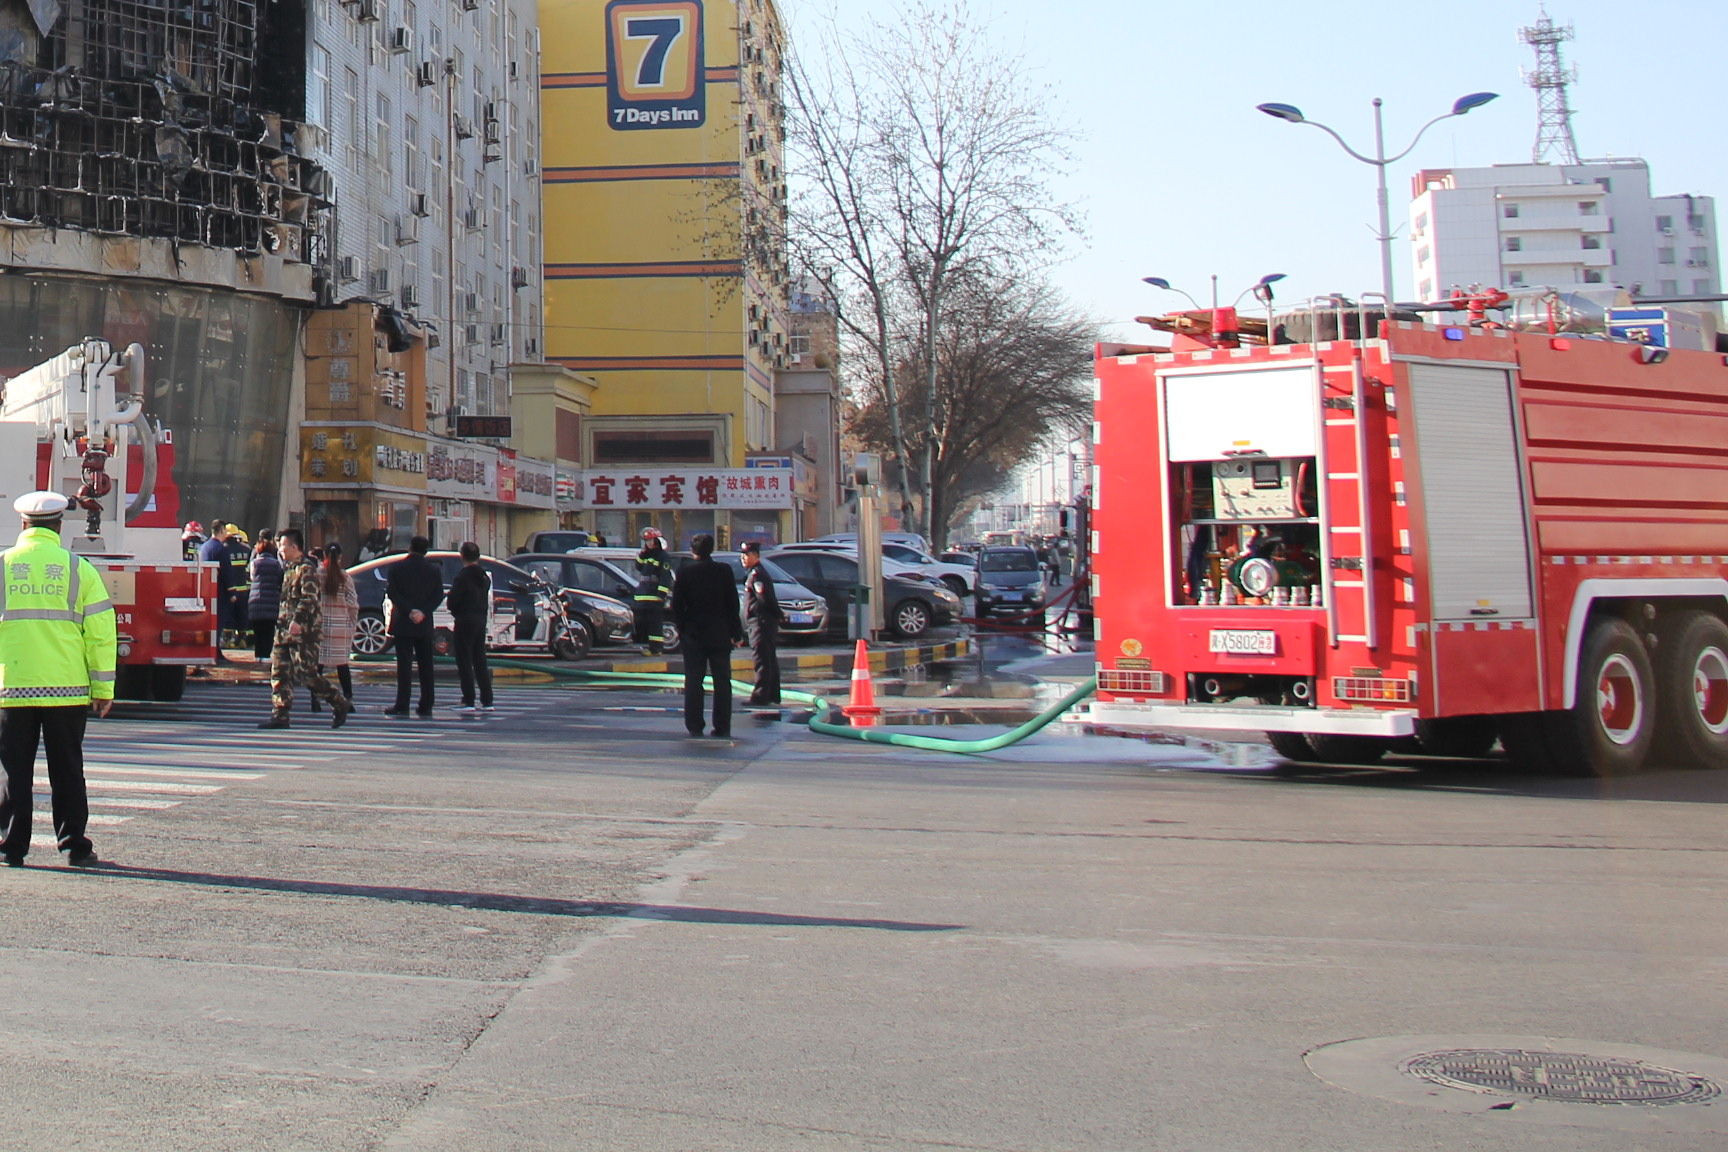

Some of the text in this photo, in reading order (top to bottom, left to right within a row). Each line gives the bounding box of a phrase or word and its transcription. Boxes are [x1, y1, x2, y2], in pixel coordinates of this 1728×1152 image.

[624, 15, 684, 88] 7
[626, 108, 670, 125] Days
[671, 106, 699, 122] Inn
[590, 474, 719, 505] 宜家宾馆
[11, 563, 65, 581] 警察
[8, 583, 65, 596] POLICE
